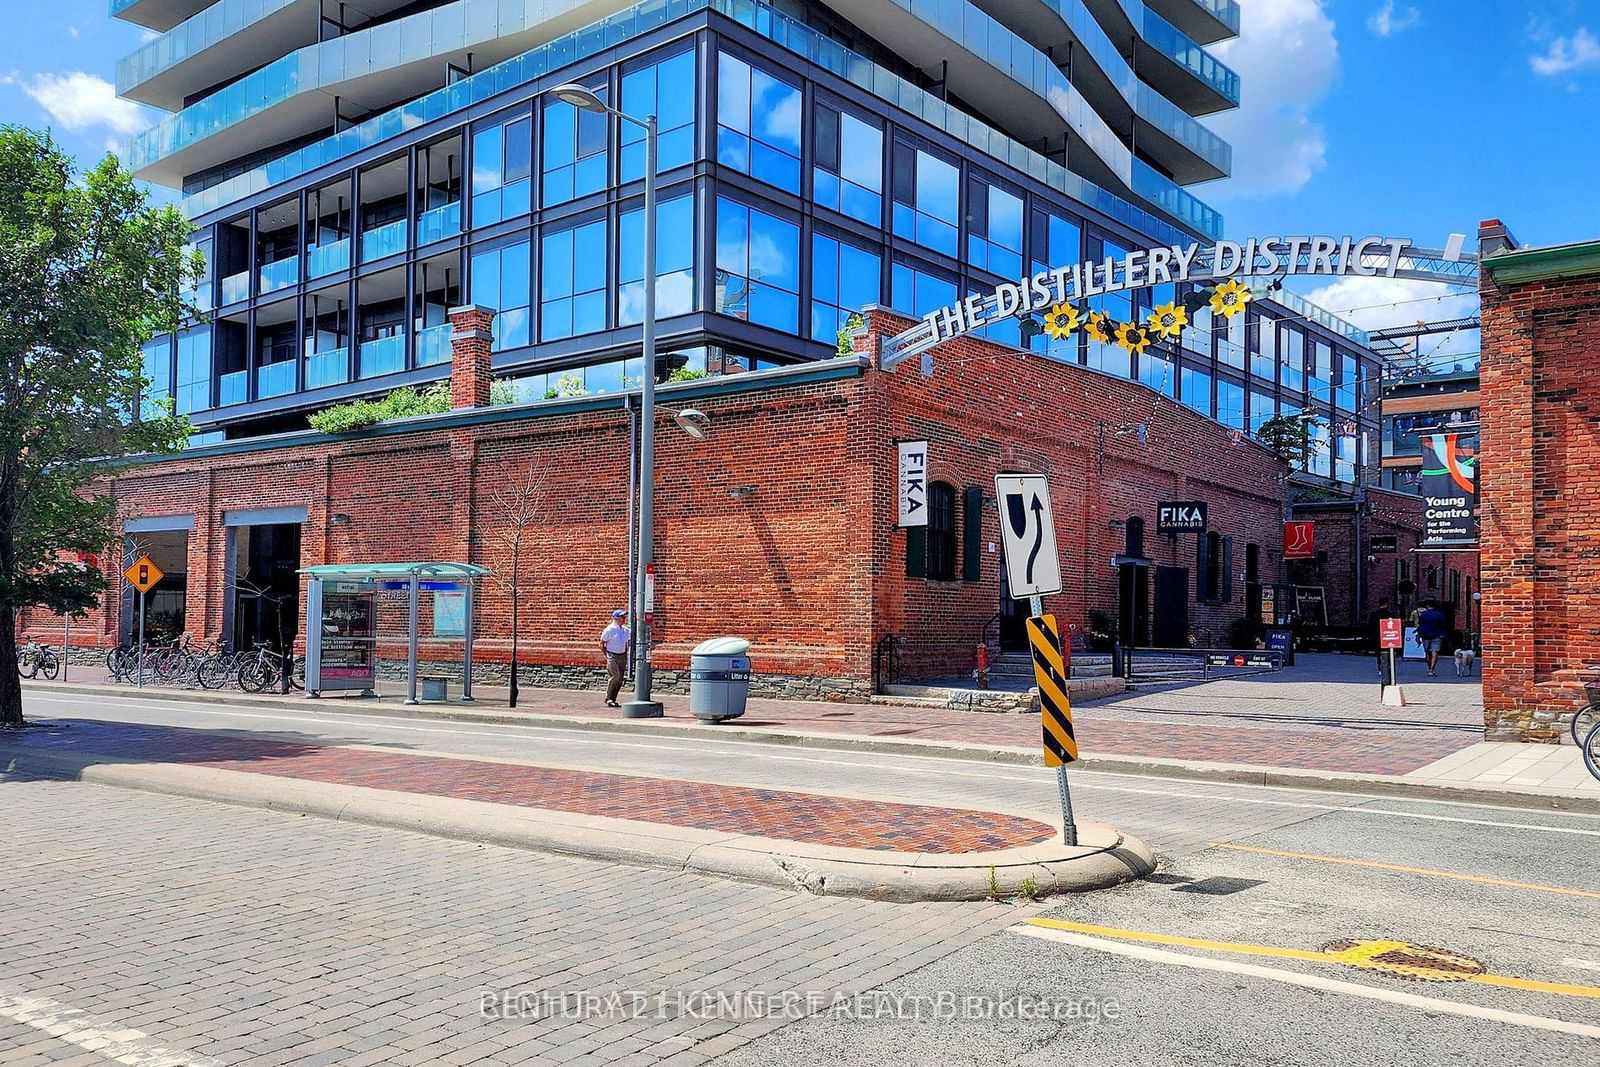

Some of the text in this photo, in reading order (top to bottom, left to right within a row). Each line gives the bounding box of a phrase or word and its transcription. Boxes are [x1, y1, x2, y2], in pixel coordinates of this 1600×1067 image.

[925, 235, 1413, 340] THE DISTILLERY DISTRICT
[907, 452, 924, 515] FIKA
[1425, 496, 1466, 508] Young
[1160, 507, 1203, 522] FIKA
[1425, 508, 1470, 519] Centre
[1427, 527, 1467, 535] Performing
[731, 672, 743, 680] Litter
